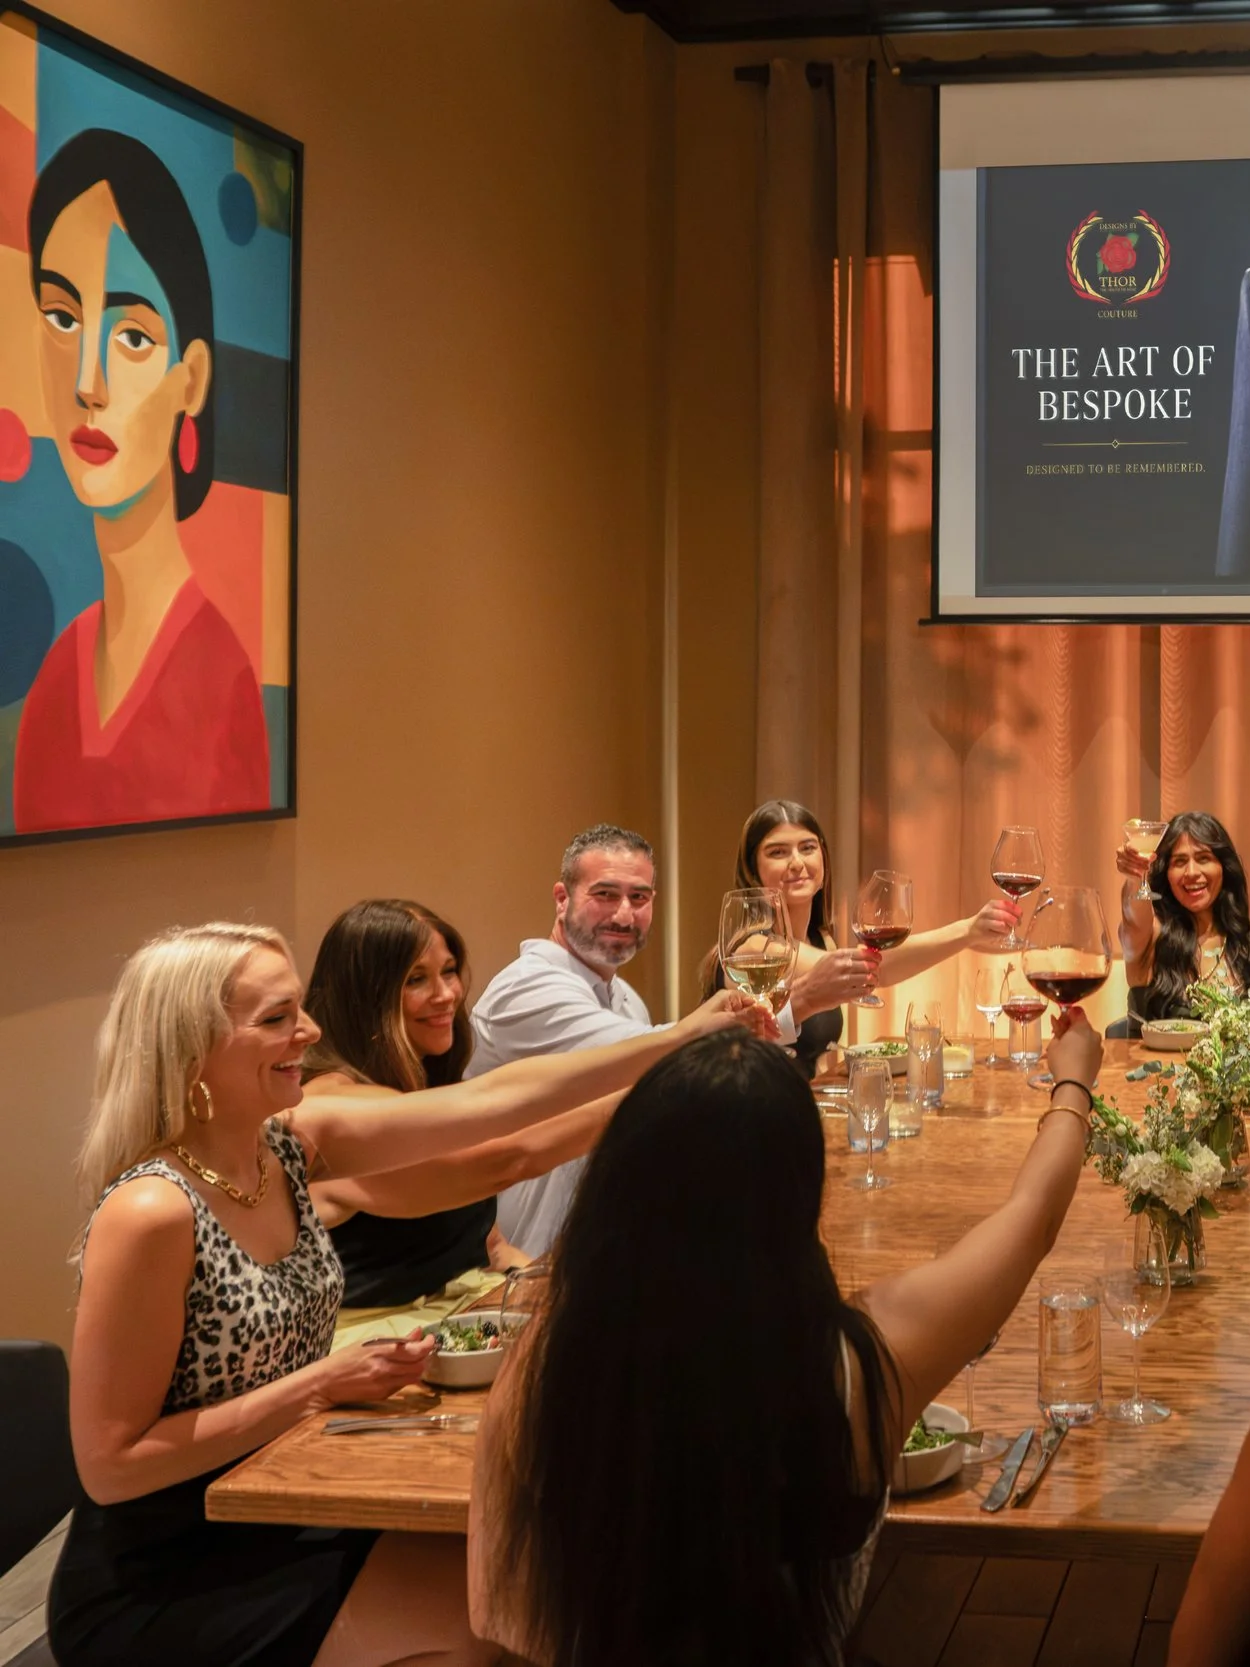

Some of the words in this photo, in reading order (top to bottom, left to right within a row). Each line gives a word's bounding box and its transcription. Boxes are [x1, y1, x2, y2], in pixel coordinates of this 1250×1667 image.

[1099, 222, 1128, 230] DESIGNS
[1129, 221, 1138, 229] BY
[1099, 276, 1137, 287] THOR
[1097, 309, 1139, 319] COUTURE
[1011, 347, 1080, 379] THE
[1092, 346, 1160, 378] ART
[1172, 345, 1216, 376] OF
[1038, 388, 1193, 421] BESPOKE
[1026, 464, 1084, 475] DESIGNED
[1088, 464, 1103, 474] TO
[1107, 464, 1121, 474] BE
[1125, 462, 1207, 474] REMEMBERED.
